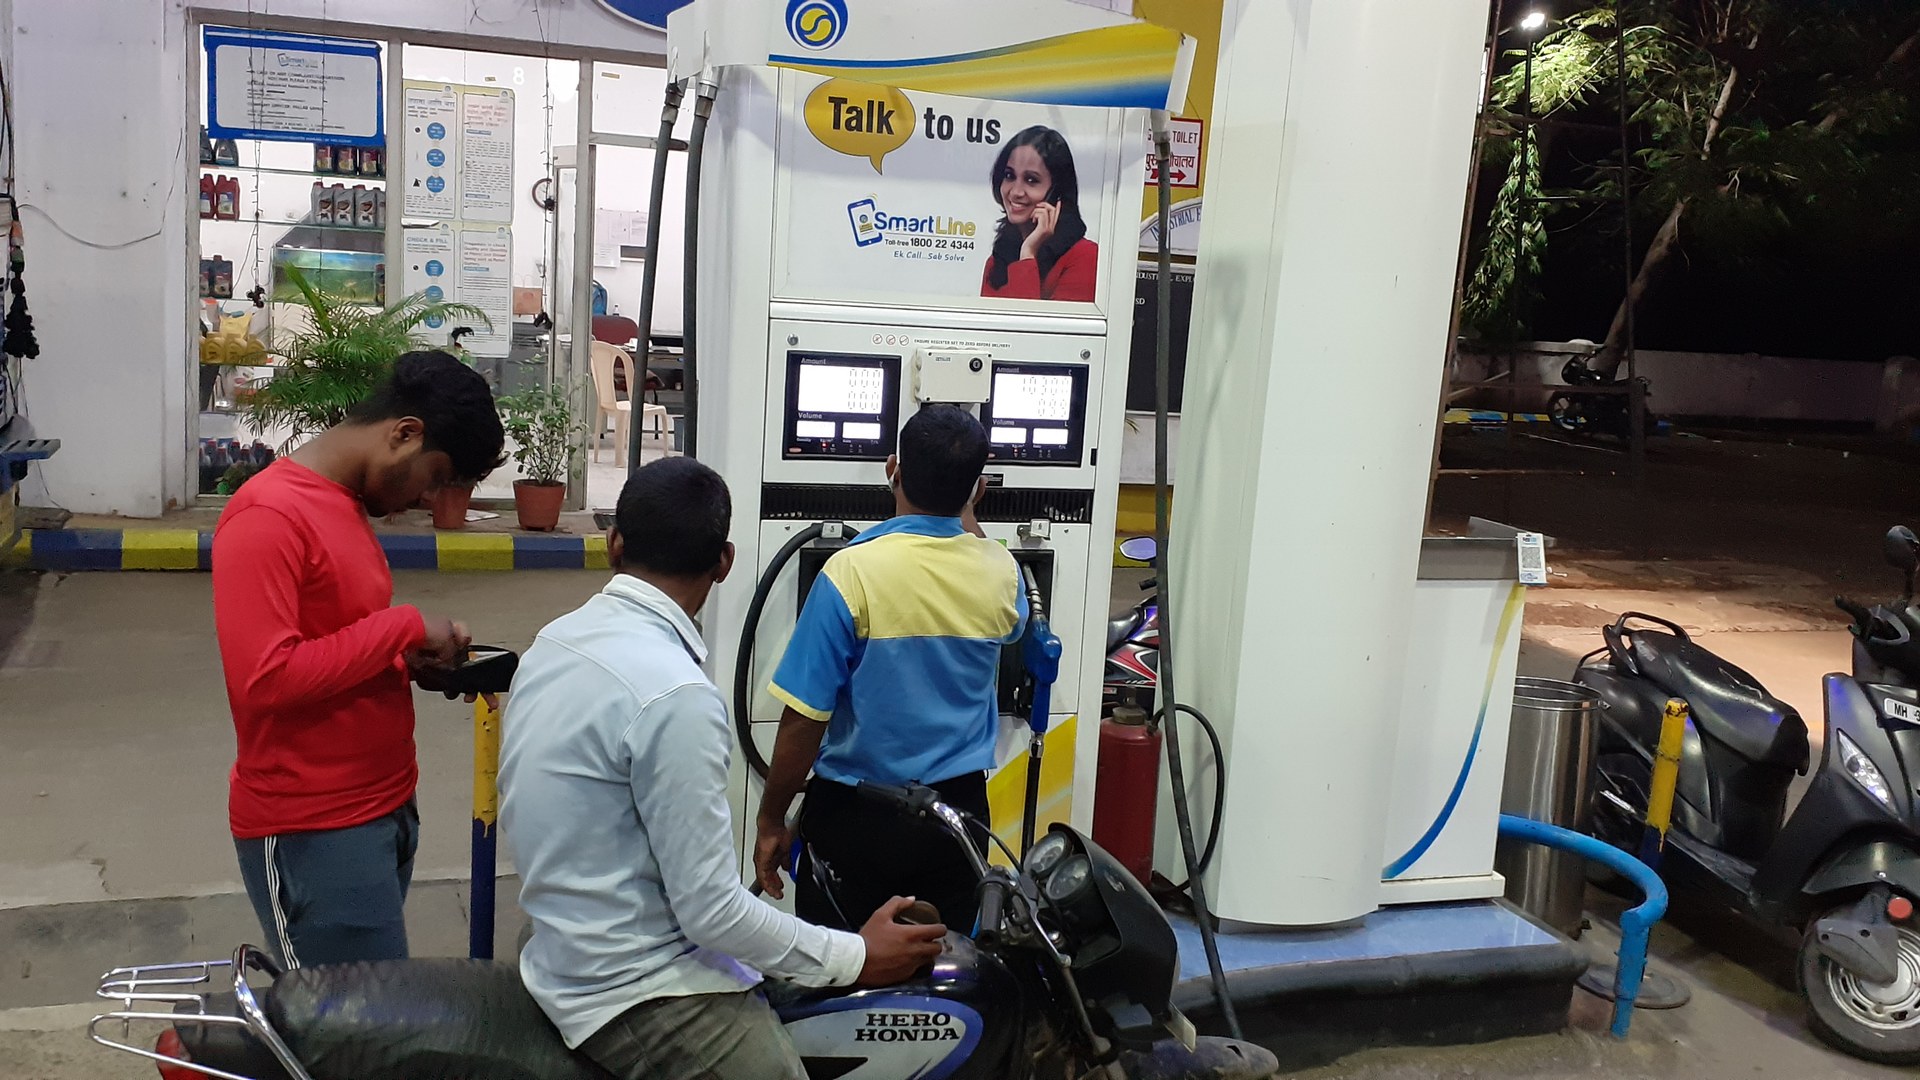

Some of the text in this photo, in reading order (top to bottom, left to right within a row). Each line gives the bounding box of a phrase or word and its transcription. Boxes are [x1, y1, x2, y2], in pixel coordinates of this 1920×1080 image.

[828, 96, 1001, 145] Talk to us
[1172, 131, 1198, 144] TOILET
[910, 238, 932, 248] 1800
[935, 239, 947, 249] 22
[950, 240, 974, 250] 4344
[893, 250, 904, 258] Ek
[944, 254, 965, 262] Solve
[801, 357, 827, 365] Amount
[1894, 703, 1908, 718] MH
[866, 1012, 951, 1027] HERO
[855, 1027, 960, 1042] HONDA
